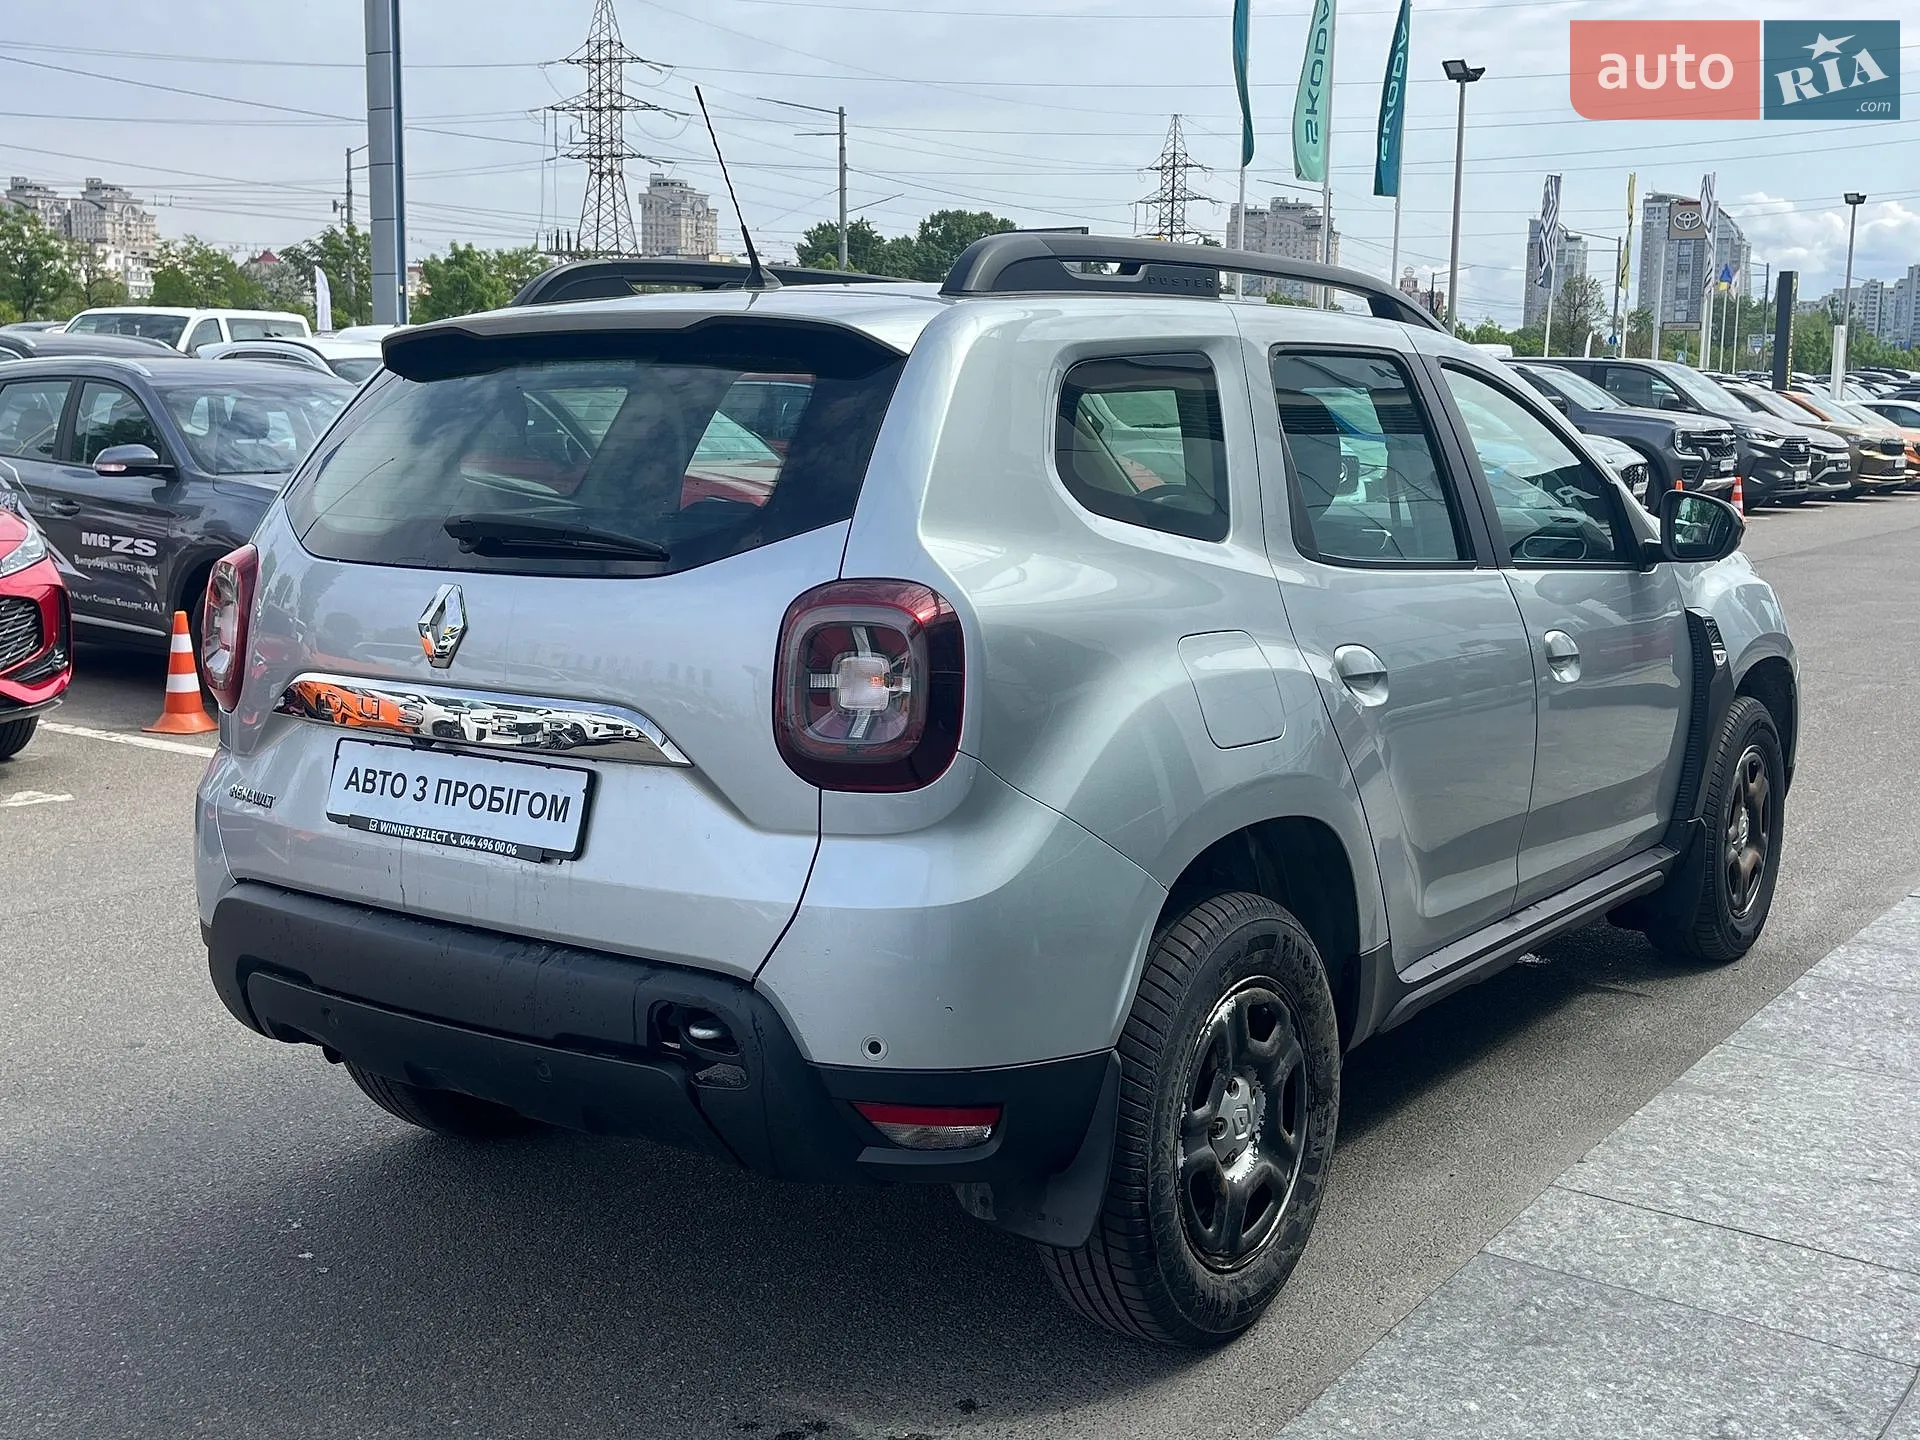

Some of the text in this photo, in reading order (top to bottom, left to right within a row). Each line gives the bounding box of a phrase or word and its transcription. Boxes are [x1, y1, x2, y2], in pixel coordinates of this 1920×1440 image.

[1147, 275, 1214, 289] DUSTER
[81, 531, 157, 557] MG ZS
[320, 691, 572, 748] DUSTER
[229, 783, 277, 809] RENAULT
[344, 766, 408, 799] АВТО
[434, 778, 571, 824] ПРОБІГОМ
[379, 821, 518, 856] WINNER SELECT 044 496 00 06
